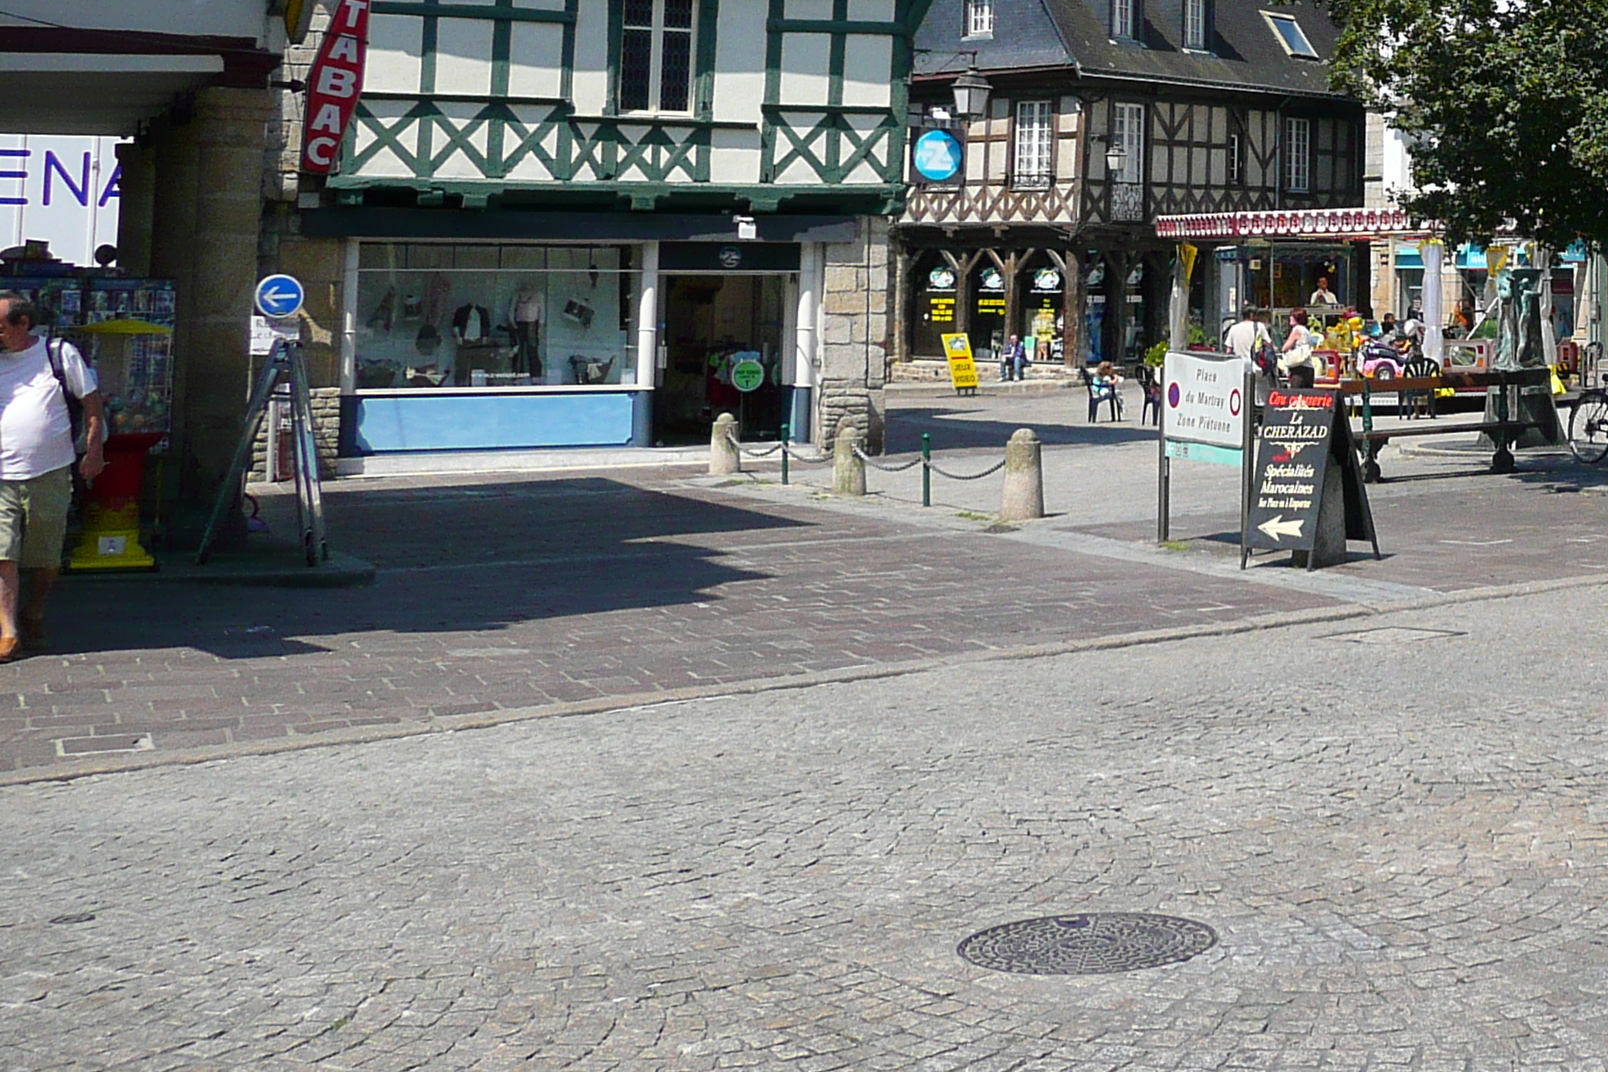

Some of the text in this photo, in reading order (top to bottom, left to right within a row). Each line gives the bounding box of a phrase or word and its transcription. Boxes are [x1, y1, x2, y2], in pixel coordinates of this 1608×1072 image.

[954, 363, 971, 371] JEUX
[955, 374, 976, 383] VIDEO
[1196, 368, 1217, 383] Place
[1185, 390, 1226, 410] du Martray
[1176, 413, 1196, 427] Zone
[1289, 412, 1303, 425] Le
[1263, 425, 1328, 439] CHERAZAD
[1264, 464, 1315, 481] Spécialités
[1260, 480, 1314, 495] Marocaines
